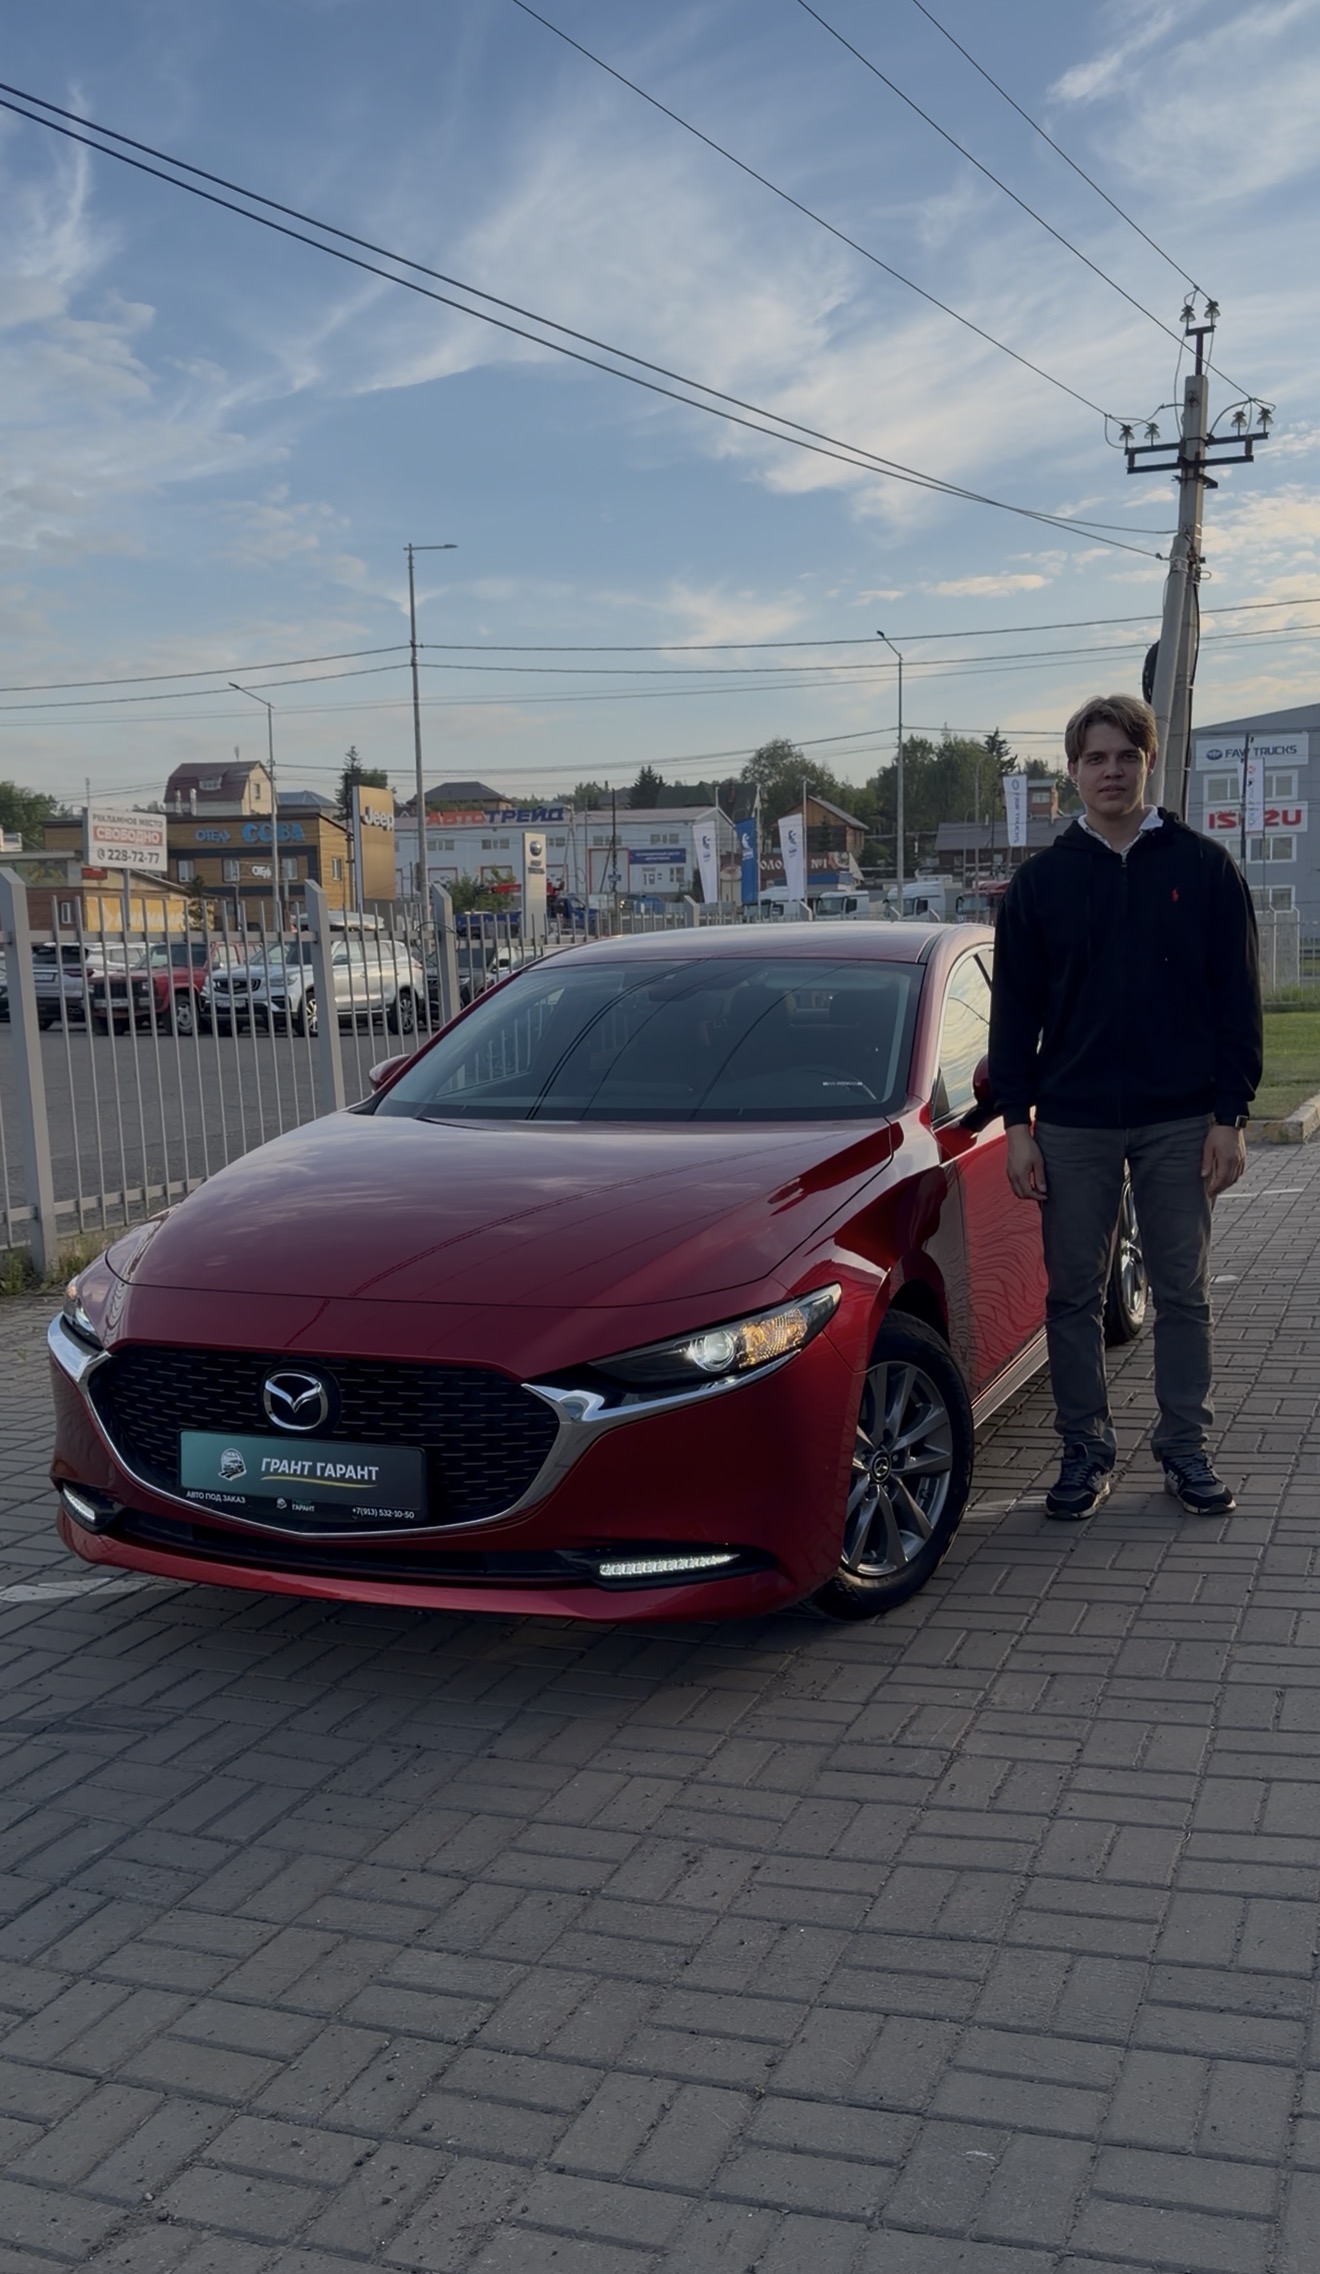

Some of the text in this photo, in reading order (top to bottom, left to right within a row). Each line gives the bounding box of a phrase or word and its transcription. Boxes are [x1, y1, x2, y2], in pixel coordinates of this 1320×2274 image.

[1253, 745, 1298, 757] TRUCKS
[138, 818, 163, 828] МЕСТО
[361, 806, 394, 831] Jeep
[425, 805, 564, 826] АВТОТРЕЙД
[1208, 809, 1303, 830] ISZU
[96, 827, 160, 845] СВОБОДНО
[242, 822, 305, 843] СОВА
[107, 849, 160, 864] 228-72-77
[261, 1457, 379, 1481] ГРАНТ ГАРАНТ
[186, 1490, 247, 1504] АВТО ПОД ЗАКАЗ
[291, 1503, 316, 1512] ГАРАНТ
[379, 1508, 415, 1520] 532-10-50
